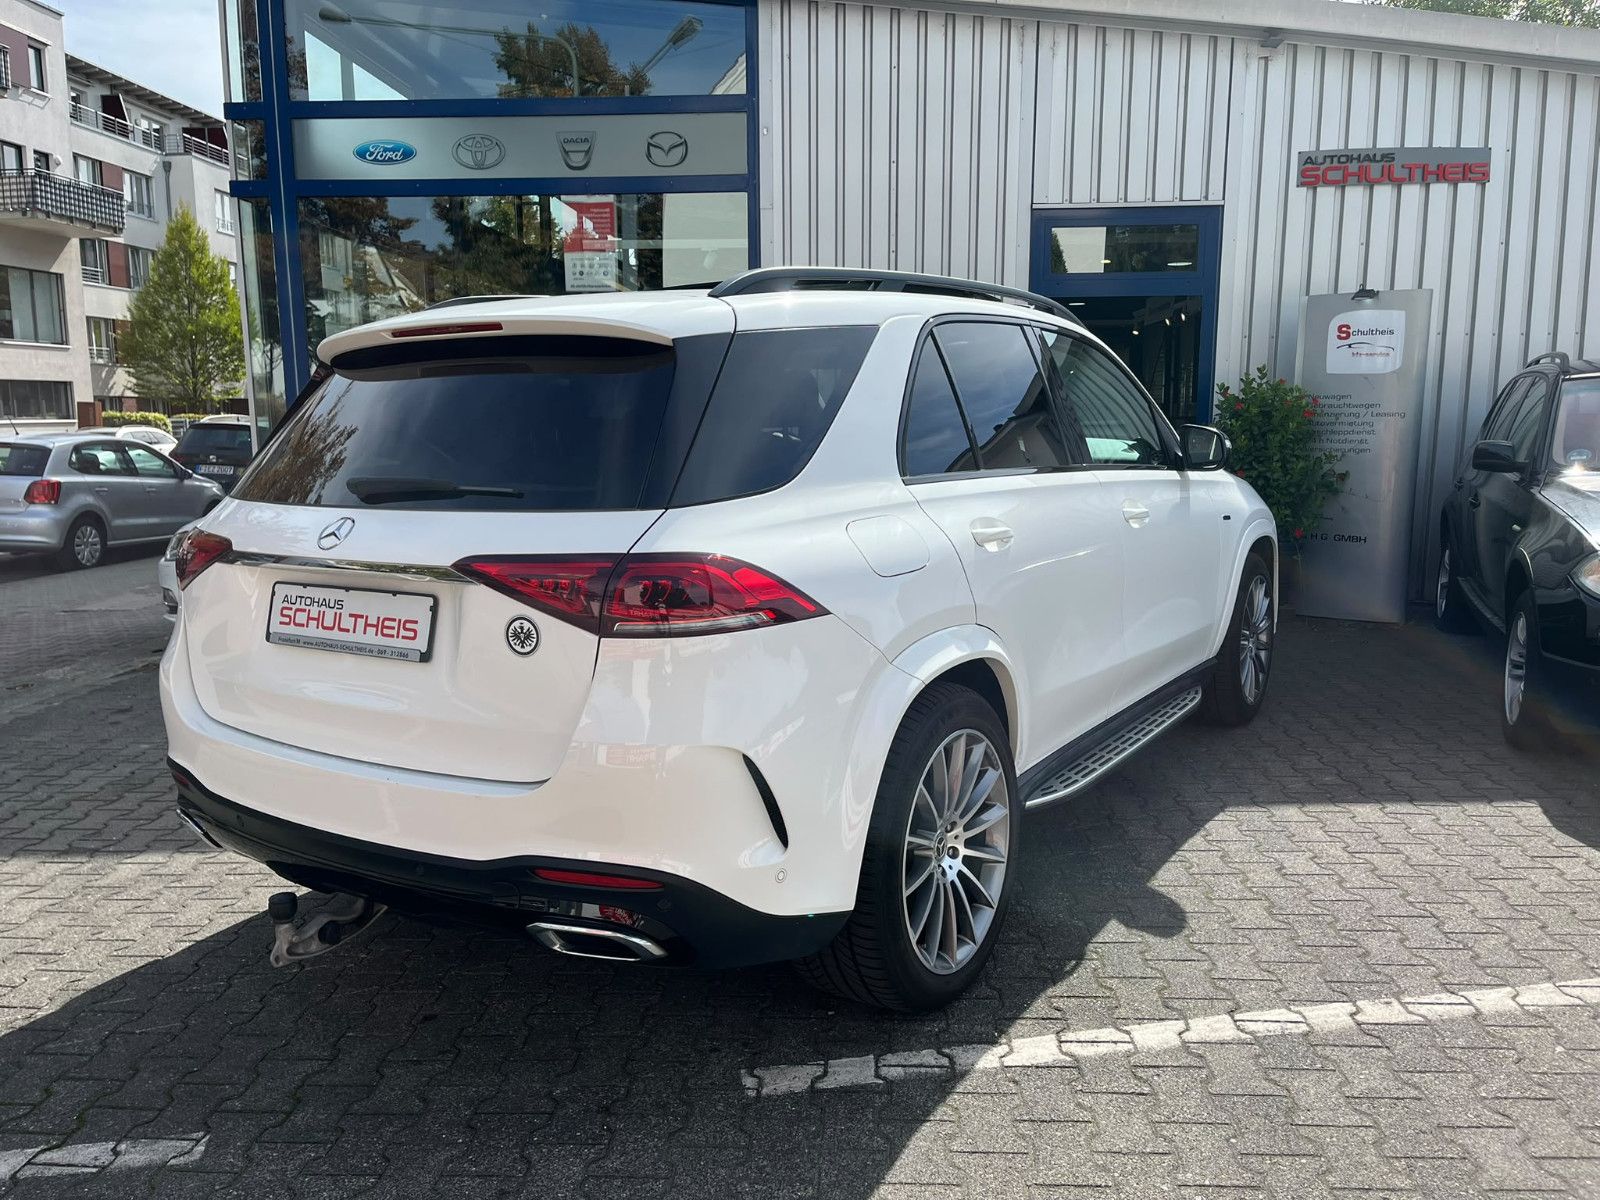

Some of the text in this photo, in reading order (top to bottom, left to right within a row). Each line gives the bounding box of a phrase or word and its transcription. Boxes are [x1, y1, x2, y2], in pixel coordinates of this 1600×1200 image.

[366, 144, 404, 160] Ford
[1302, 152, 1396, 166] AUTOHAUS
[1300, 162, 1489, 186] SCHULTHEIS
[1336, 324, 1395, 340] Schultheis
[1311, 402, 1381, 410] ebrauchtwagen
[1371, 411, 1406, 419] Leasing
[1333, 534, 1366, 543] GMBH
[281, 594, 344, 610] AUTOHAUS
[278, 606, 419, 641] SCHULTHEIS
